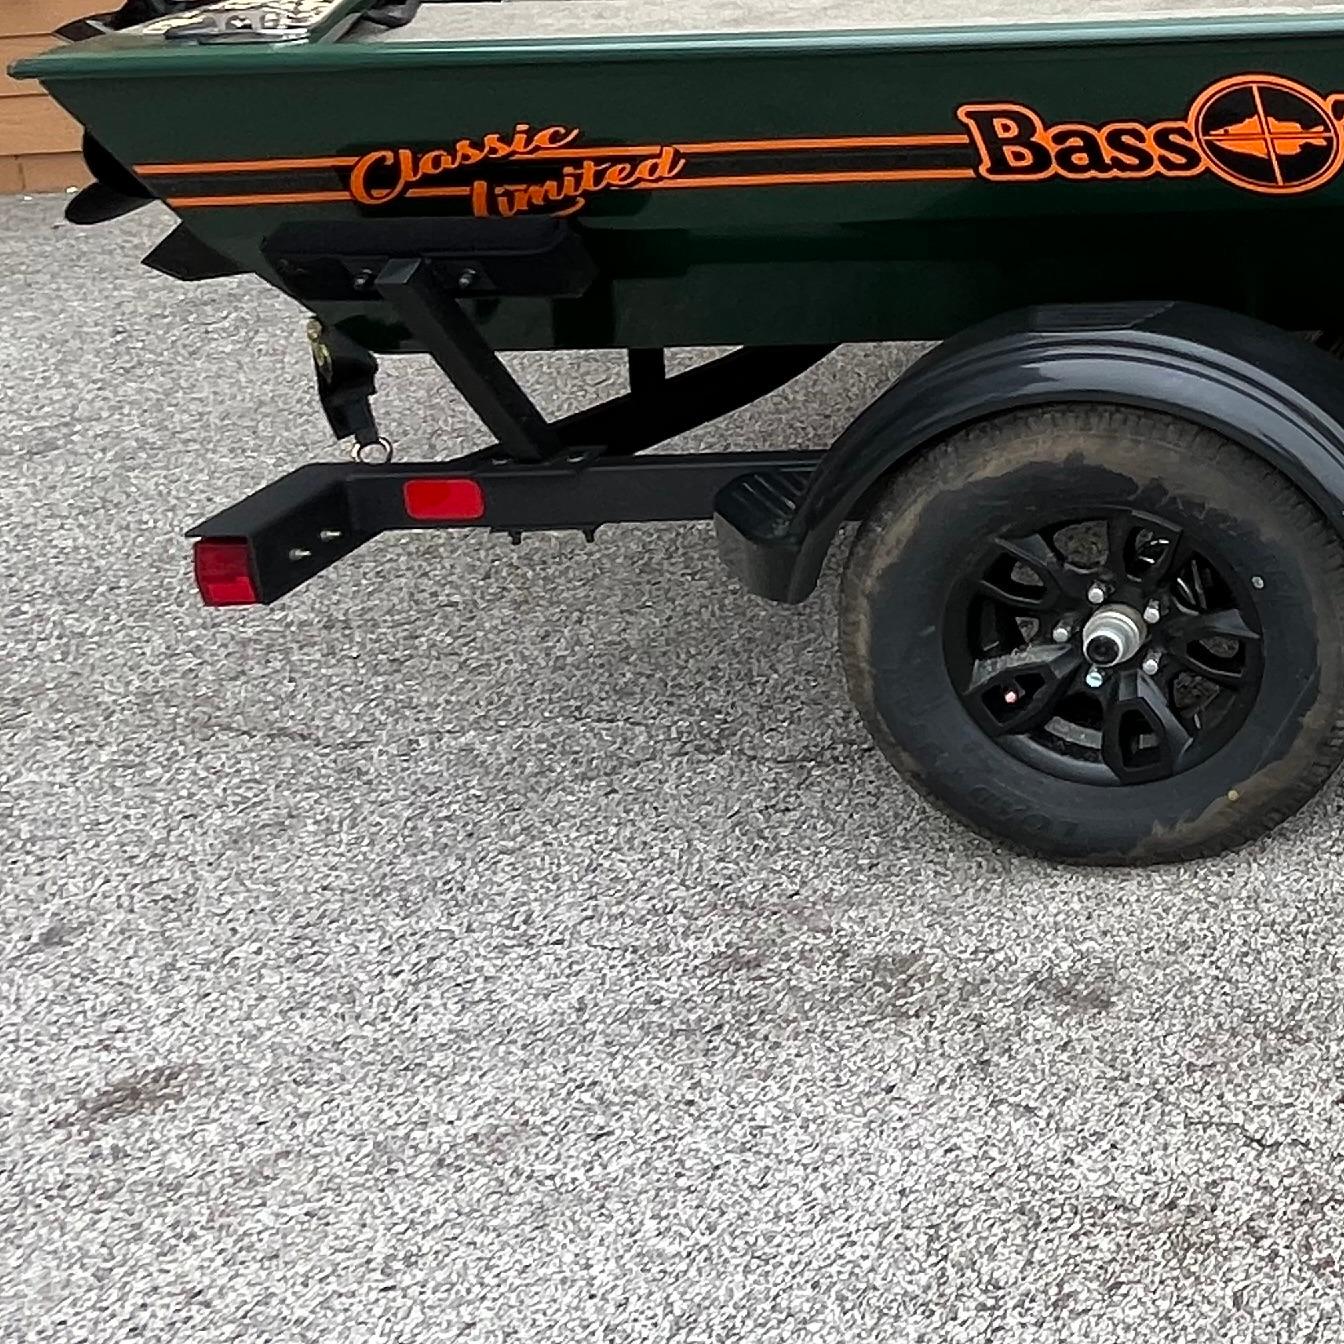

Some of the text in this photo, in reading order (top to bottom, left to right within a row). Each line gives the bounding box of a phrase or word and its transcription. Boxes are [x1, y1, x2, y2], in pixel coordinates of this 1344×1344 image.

[351, 124, 580, 205] Classic
[471, 145, 686, 218] Limited
[956, 102, 1207, 183] Bass
